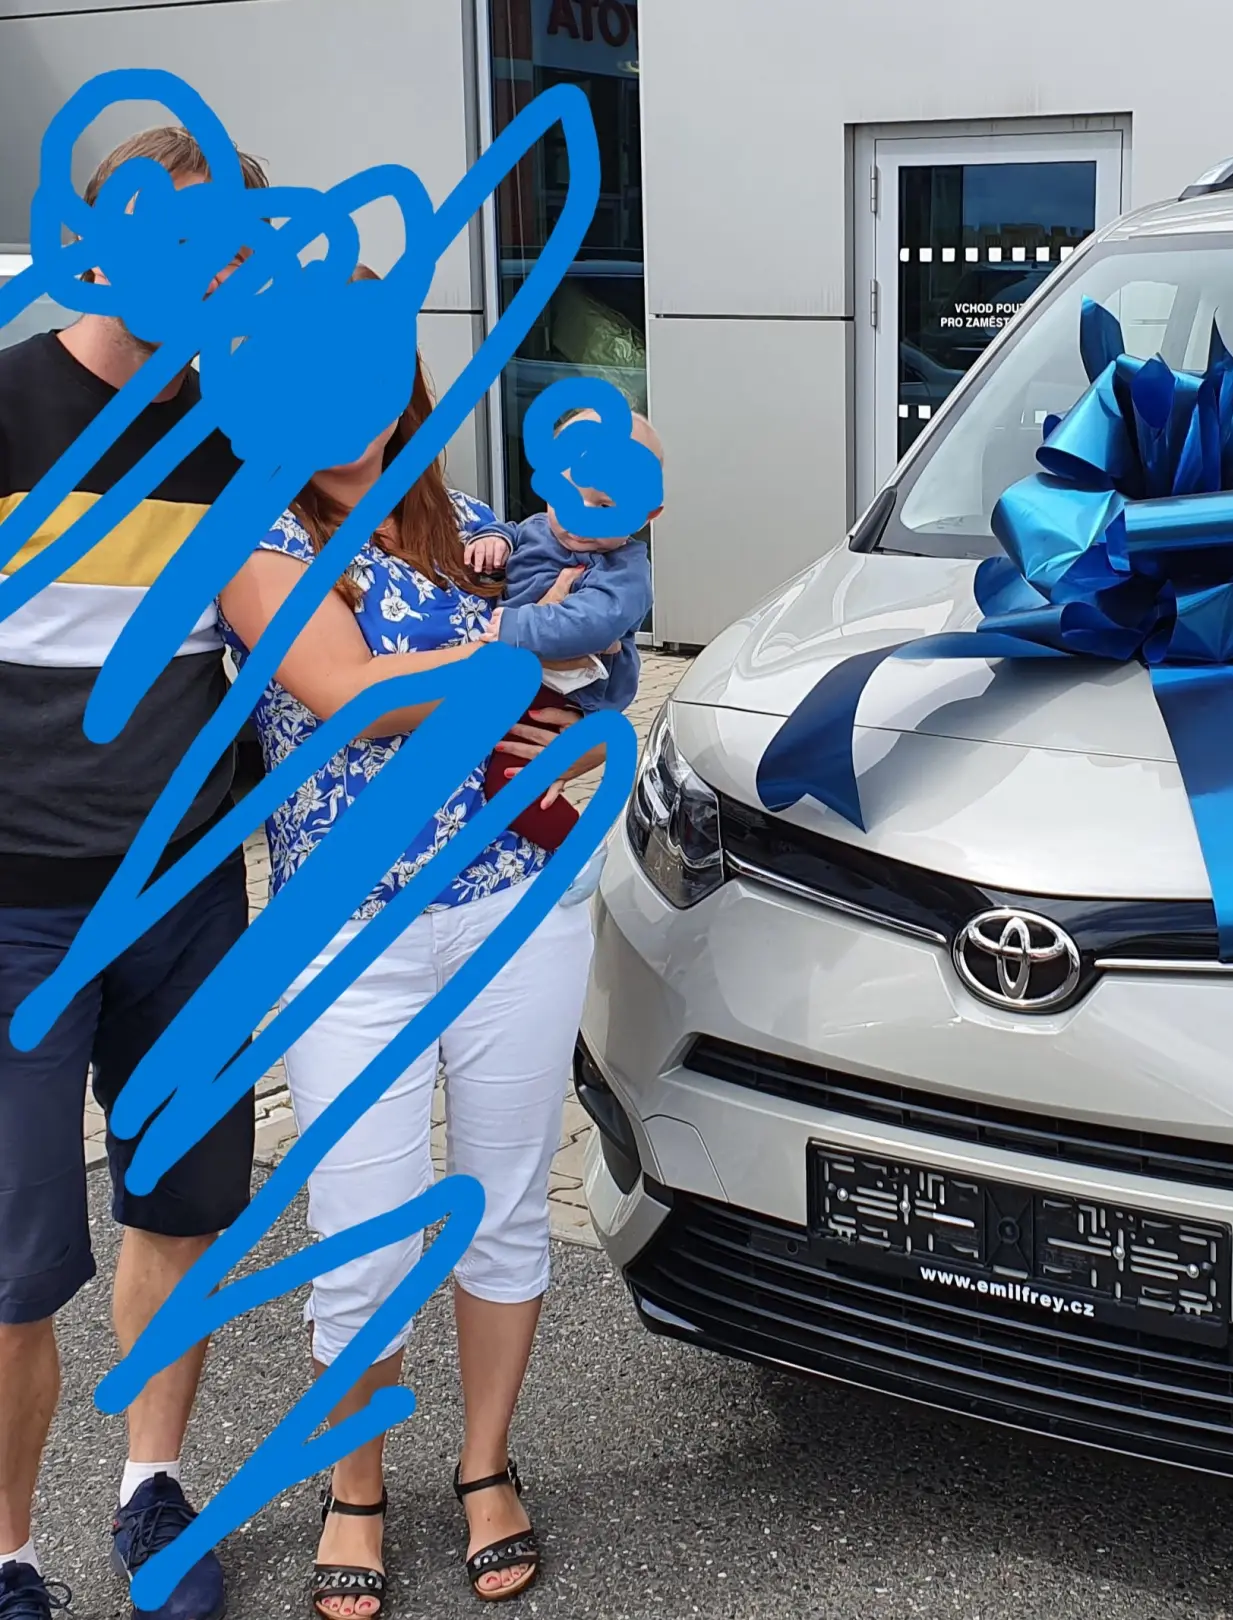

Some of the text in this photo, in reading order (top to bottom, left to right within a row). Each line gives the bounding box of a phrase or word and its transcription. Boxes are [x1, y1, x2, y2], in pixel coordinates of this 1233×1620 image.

[955, 303, 1024, 313] VCHOD POU
[940, 317, 963, 327] PRO
[920, 1266, 1095, 1317] www.emilfrey.cz
